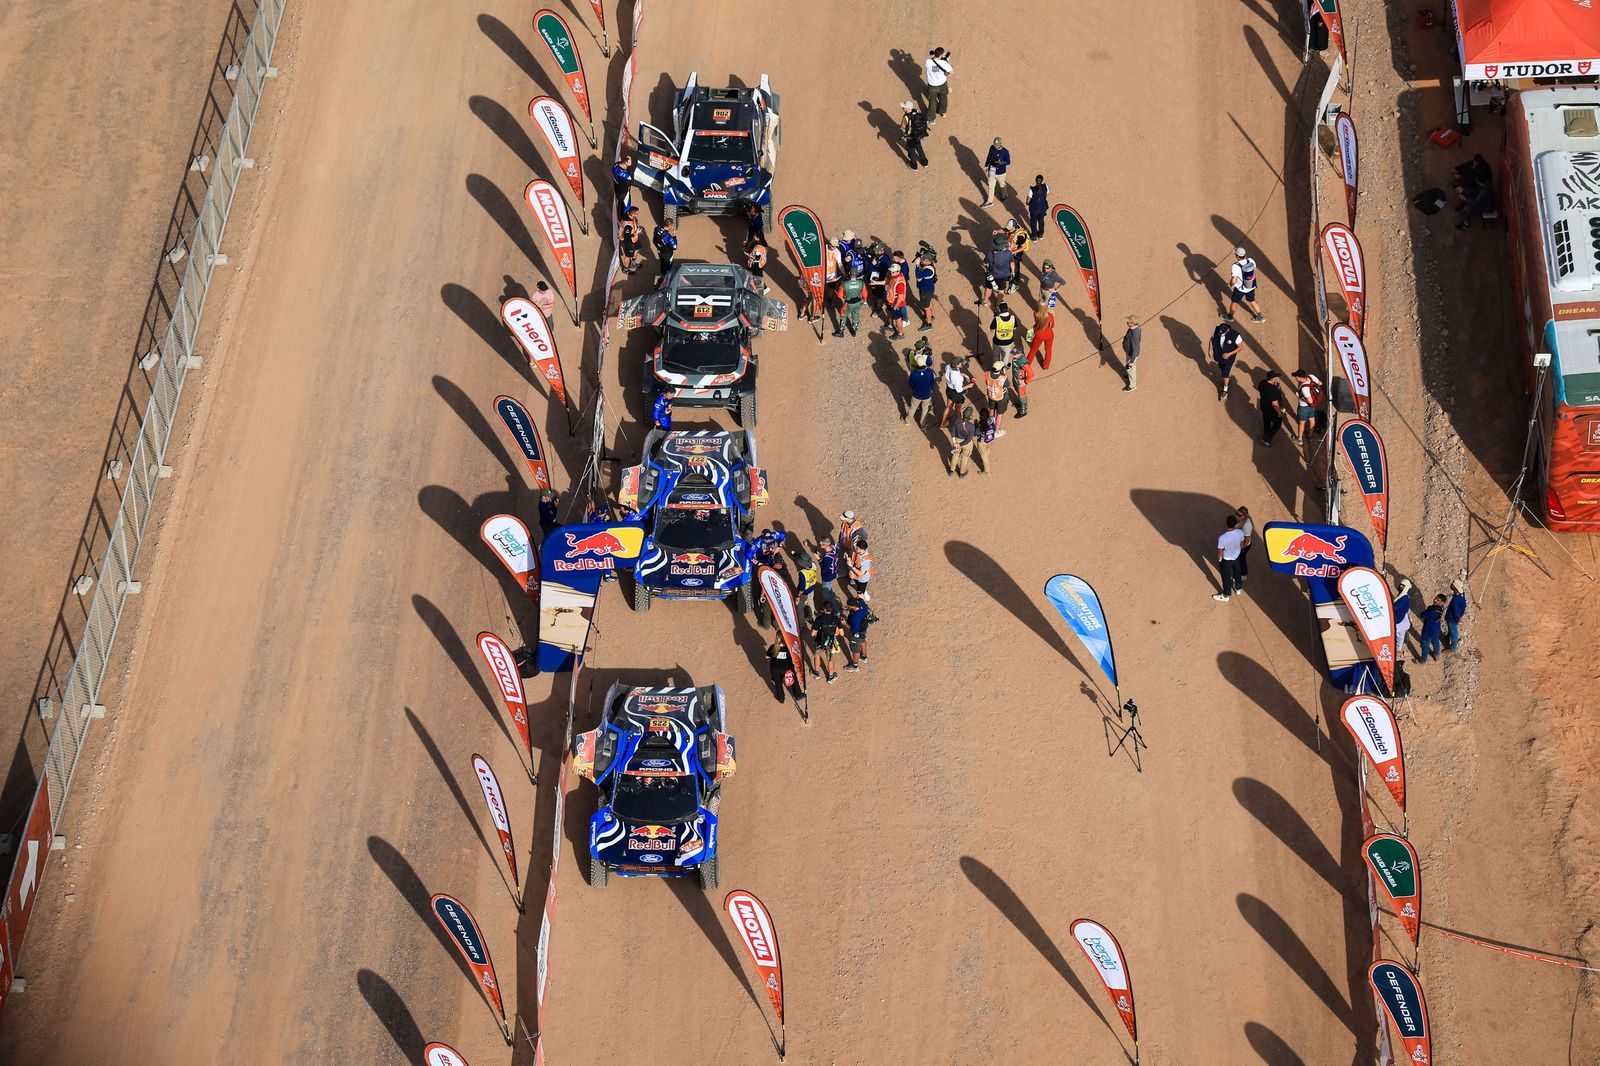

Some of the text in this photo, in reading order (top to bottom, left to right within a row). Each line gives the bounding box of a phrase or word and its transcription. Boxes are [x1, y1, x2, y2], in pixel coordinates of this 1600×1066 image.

[1503, 64, 1572, 77] TUDOR
[543, 105, 568, 152] BFGoodrich
[537, 191, 564, 242] MOTUL
[1334, 235, 1357, 287] MOTUL
[522, 322, 548, 352] Hero
[1347, 352, 1365, 388] Hero
[506, 405, 535, 456] DEFENDER
[1353, 431, 1377, 489] DEFENDER
[500, 527, 525, 556] berain
[554, 557, 615, 571] Red Bull
[671, 565, 693, 575] Red
[694, 565, 714, 574] Bull
[1295, 563, 1326, 577] Red
[1358, 583, 1384, 619] berain
[488, 644, 518, 695] MOTUL
[664, 695, 688, 703] Red
[1359, 705, 1388, 755] BFGoodrich
[487, 785, 505, 824] Hero
[628, 840, 651, 850] Red
[652, 840, 675, 850] Bull
[1372, 852, 1385, 870] SAUDI
[445, 904, 480, 960] DEFENDER
[738, 903, 769, 960] MOTUL
[1090, 937, 1117, 970] berain
[1386, 971, 1416, 1032] DEFENDER
